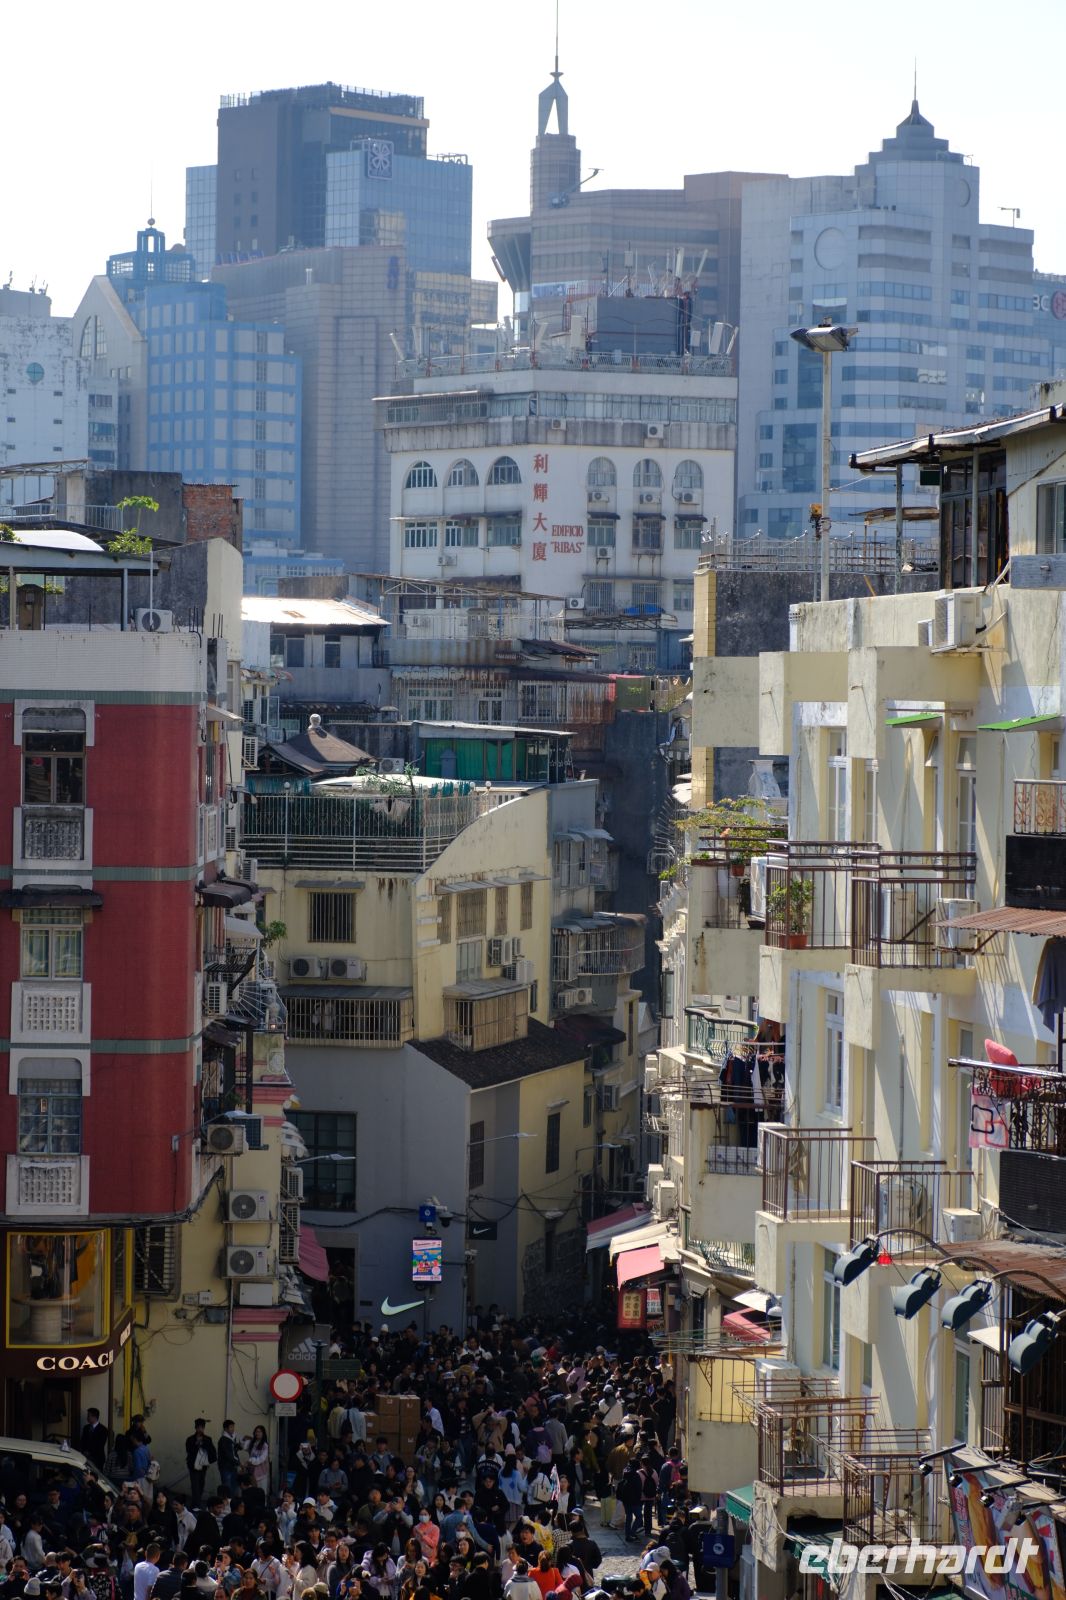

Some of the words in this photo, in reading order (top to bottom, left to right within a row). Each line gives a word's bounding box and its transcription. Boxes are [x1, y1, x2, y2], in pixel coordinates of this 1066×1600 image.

[532, 453, 549, 561] 利輝大廈
[551, 524, 584, 537] EDIFICIO
[287, 1351, 317, 1361] adida
